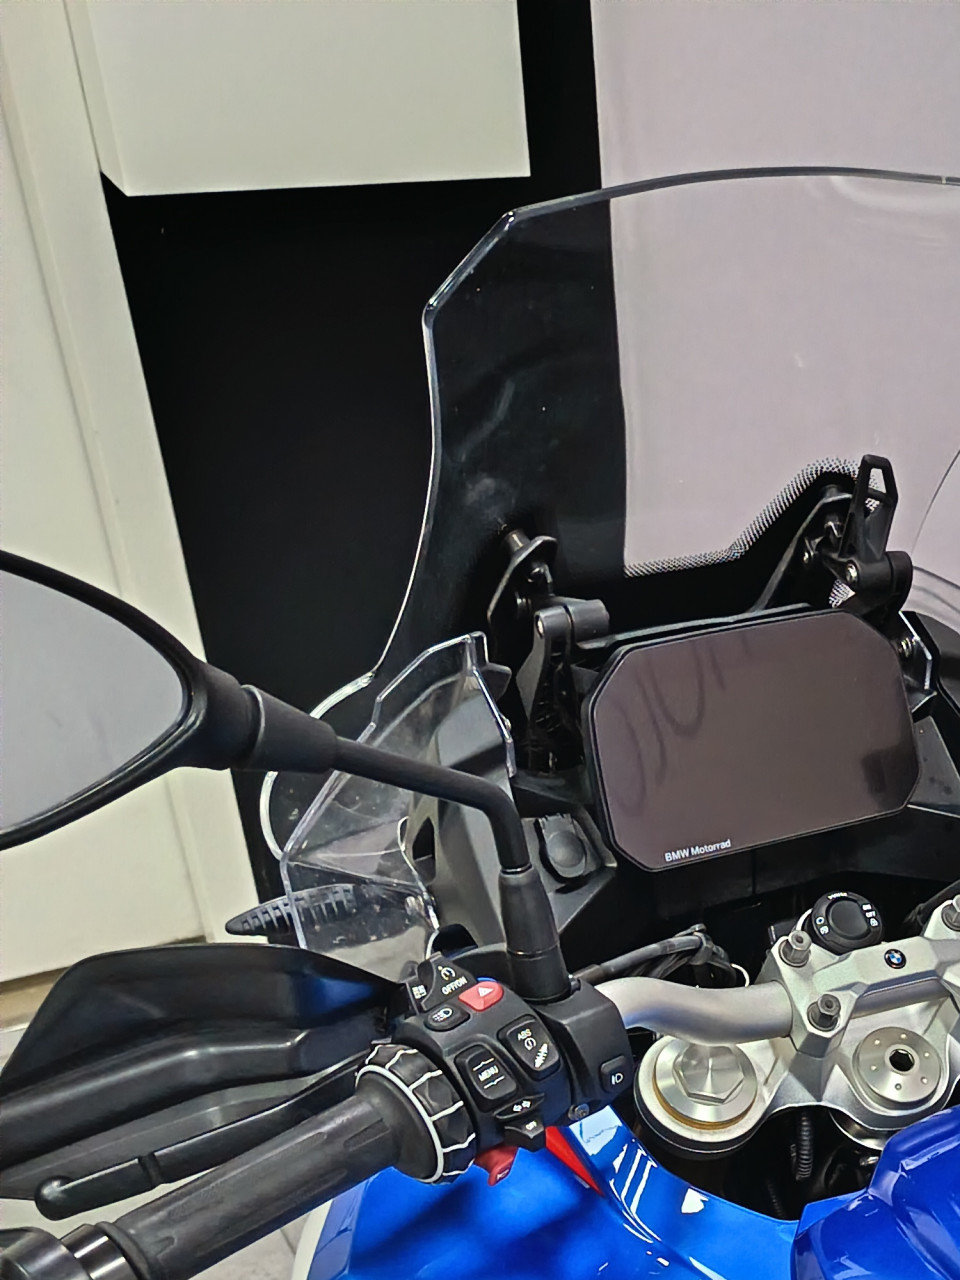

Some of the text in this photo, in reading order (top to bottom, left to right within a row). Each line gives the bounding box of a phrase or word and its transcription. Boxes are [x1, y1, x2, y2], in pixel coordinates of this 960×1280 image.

[664, 838, 732, 862] BMW Motorrad
[517, 1028, 532, 1041] ABS
[478, 1065, 499, 1082] MENU
